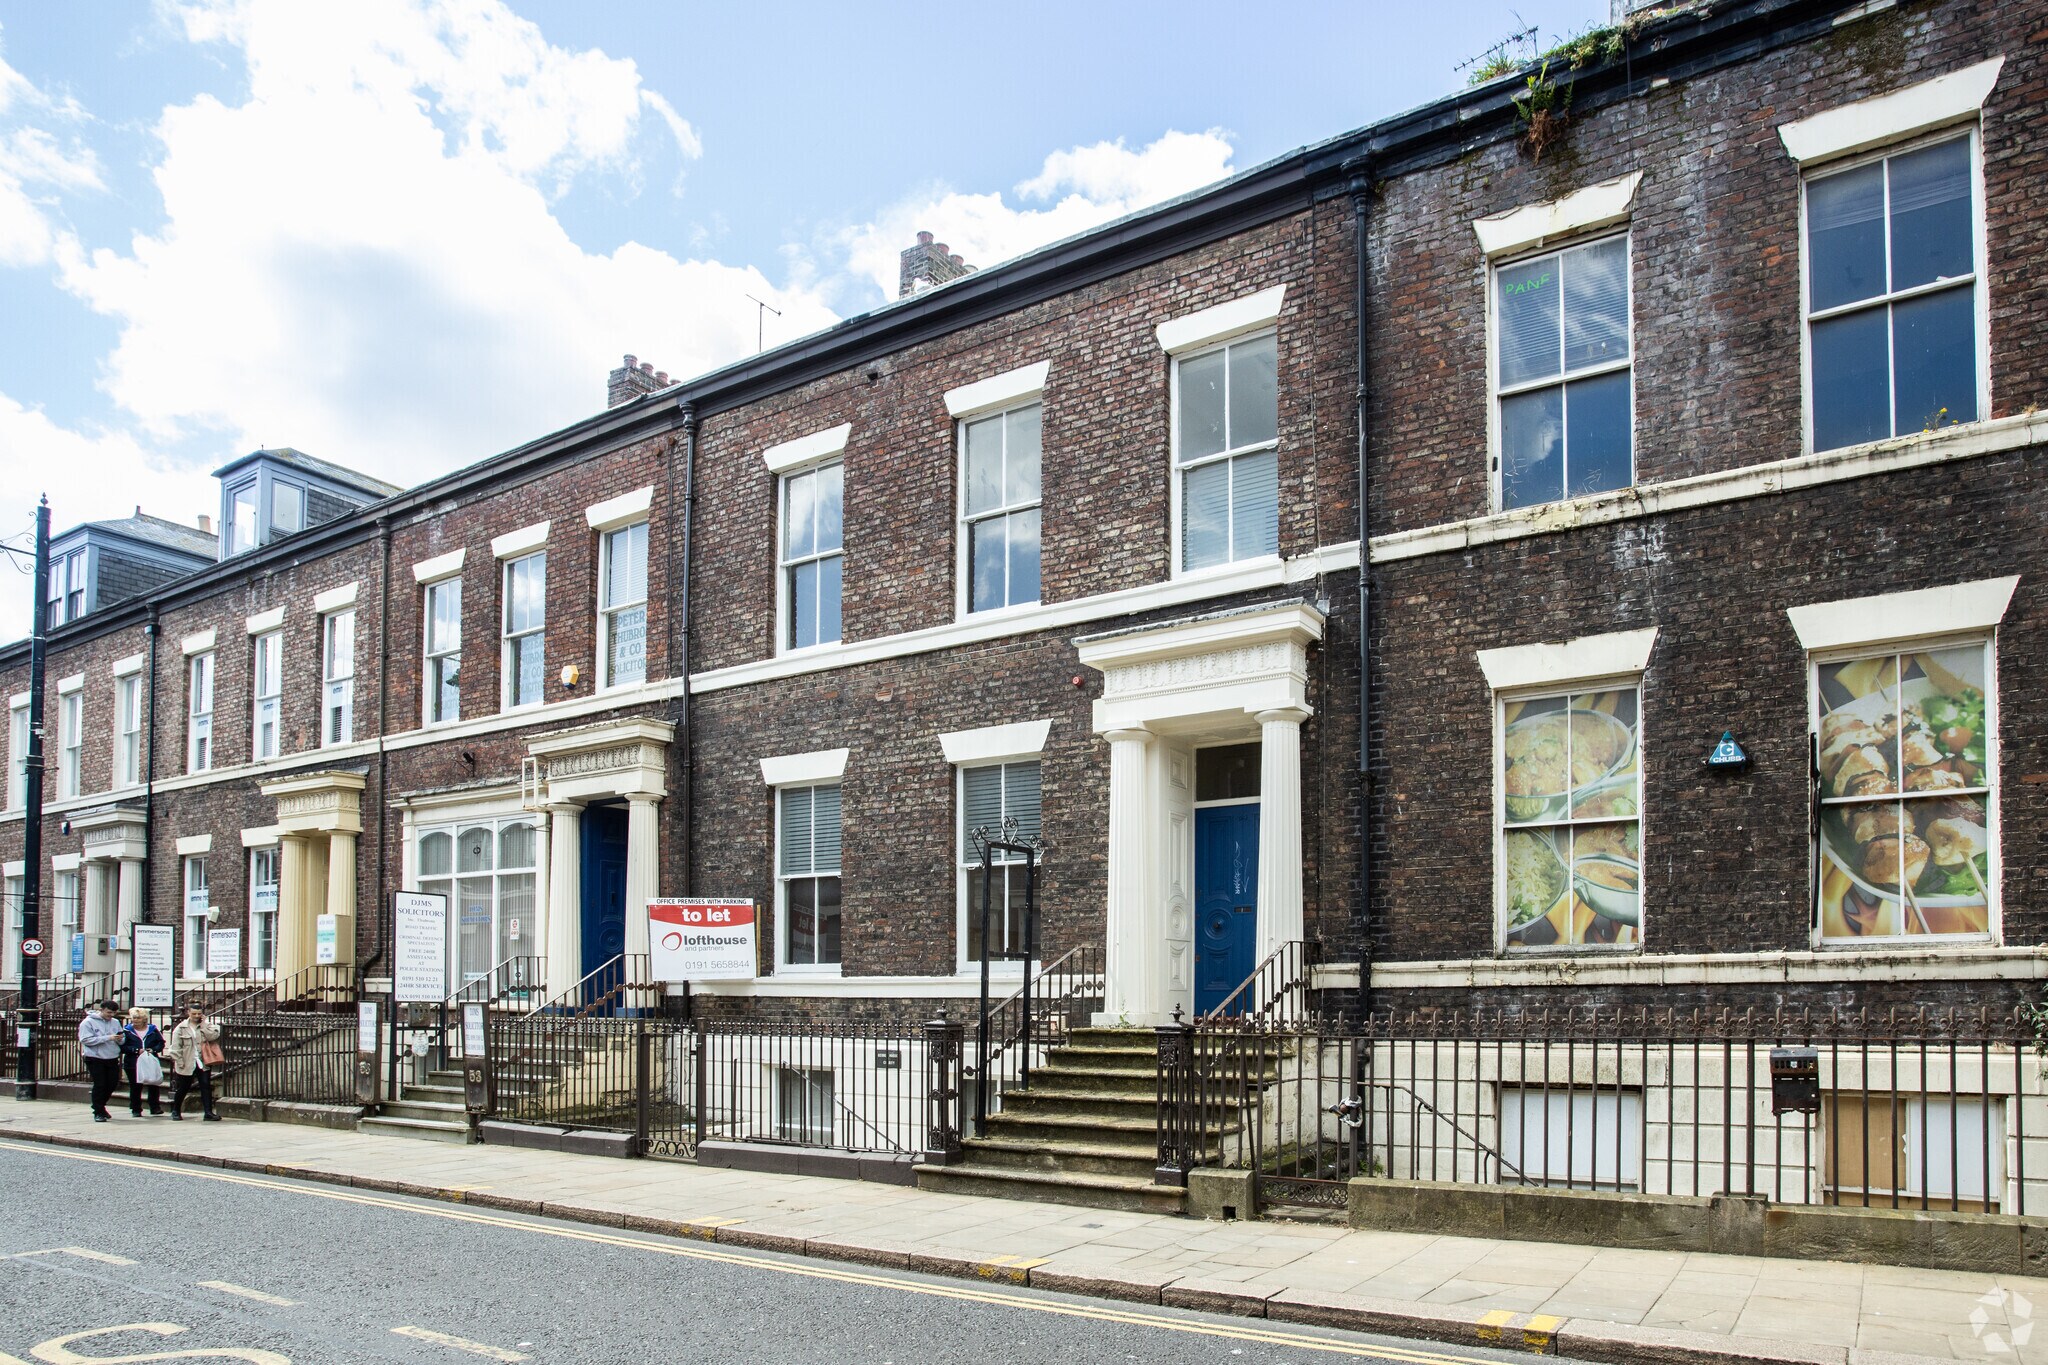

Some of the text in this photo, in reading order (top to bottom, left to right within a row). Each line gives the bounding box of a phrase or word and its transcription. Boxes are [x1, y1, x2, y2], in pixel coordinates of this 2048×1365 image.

[618, 610, 645, 627] PETER
[620, 642, 640, 657] & CO
[398, 908, 444, 917] SOLICITORS
[682, 908, 730, 922] to let
[684, 936, 747, 946] lofthouse
[25, 943, 42, 951] 20
[685, 960, 750, 970] 0191 5658844
[469, 1070, 482, 1083] 53
